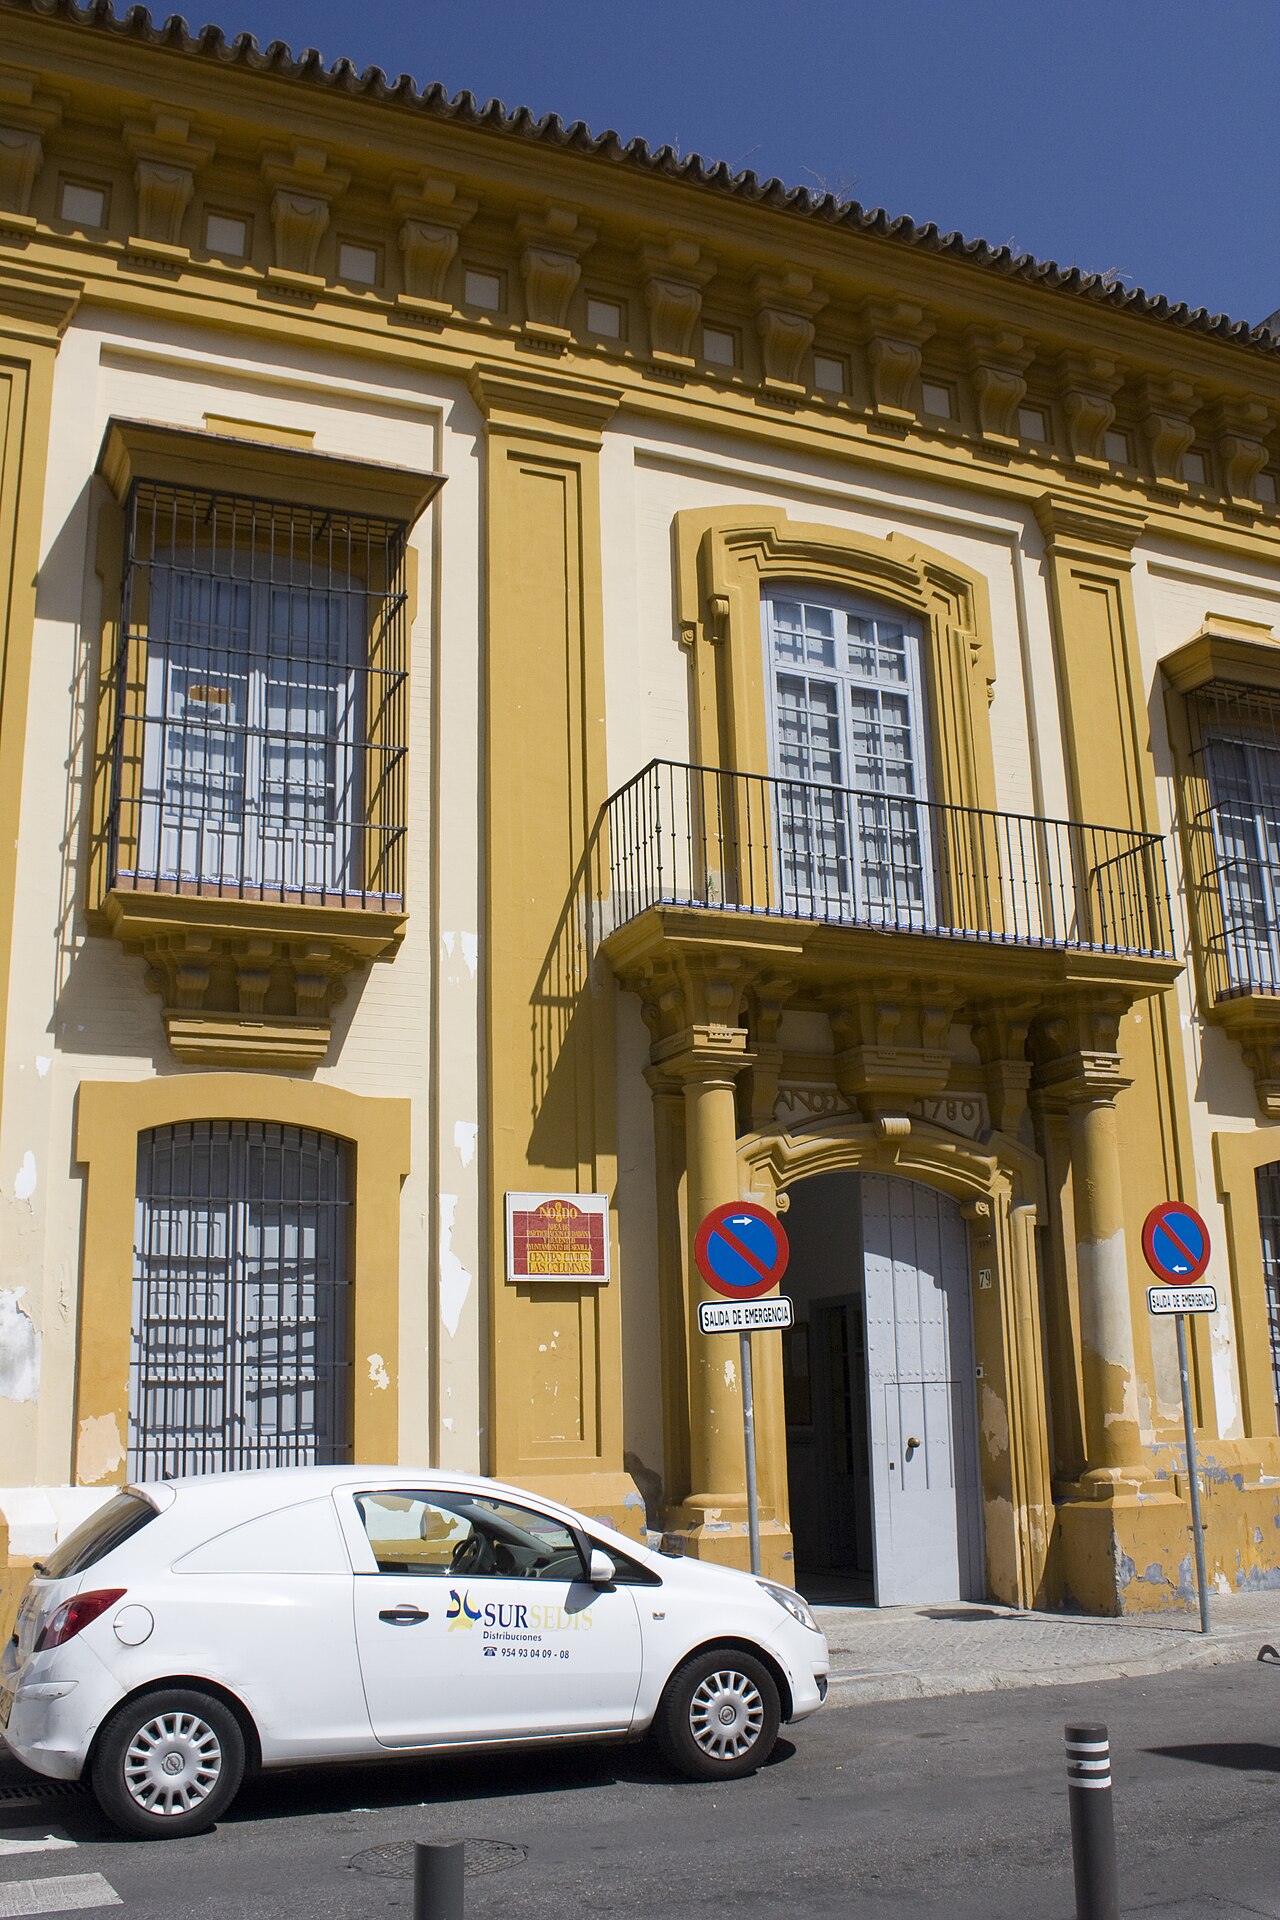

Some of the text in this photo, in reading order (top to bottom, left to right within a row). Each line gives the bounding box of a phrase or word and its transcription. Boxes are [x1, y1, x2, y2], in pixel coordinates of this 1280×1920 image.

[917, 1097, 974, 1121] 1780
[571, 1243, 593, 1252] SEVILLA
[529, 1251, 562, 1262] CENTRO
[529, 1261, 591, 1273] LAS COLUMNAS
[980, 1270, 991, 1288] 79
[1152, 1293, 1214, 1308] SALIDA DE EMERGENCIA
[704, 1306, 789, 1327] SALIDA DE EMERGENCIA
[483, 1631, 542, 1642] Distribuciones
[501, 1647, 516, 1657] 954
[518, 1648, 528, 1658] 93
[530, 1648, 540, 1658] 04
[542, 1649, 552, 1659] 09
[560, 1649, 570, 1659] 08
